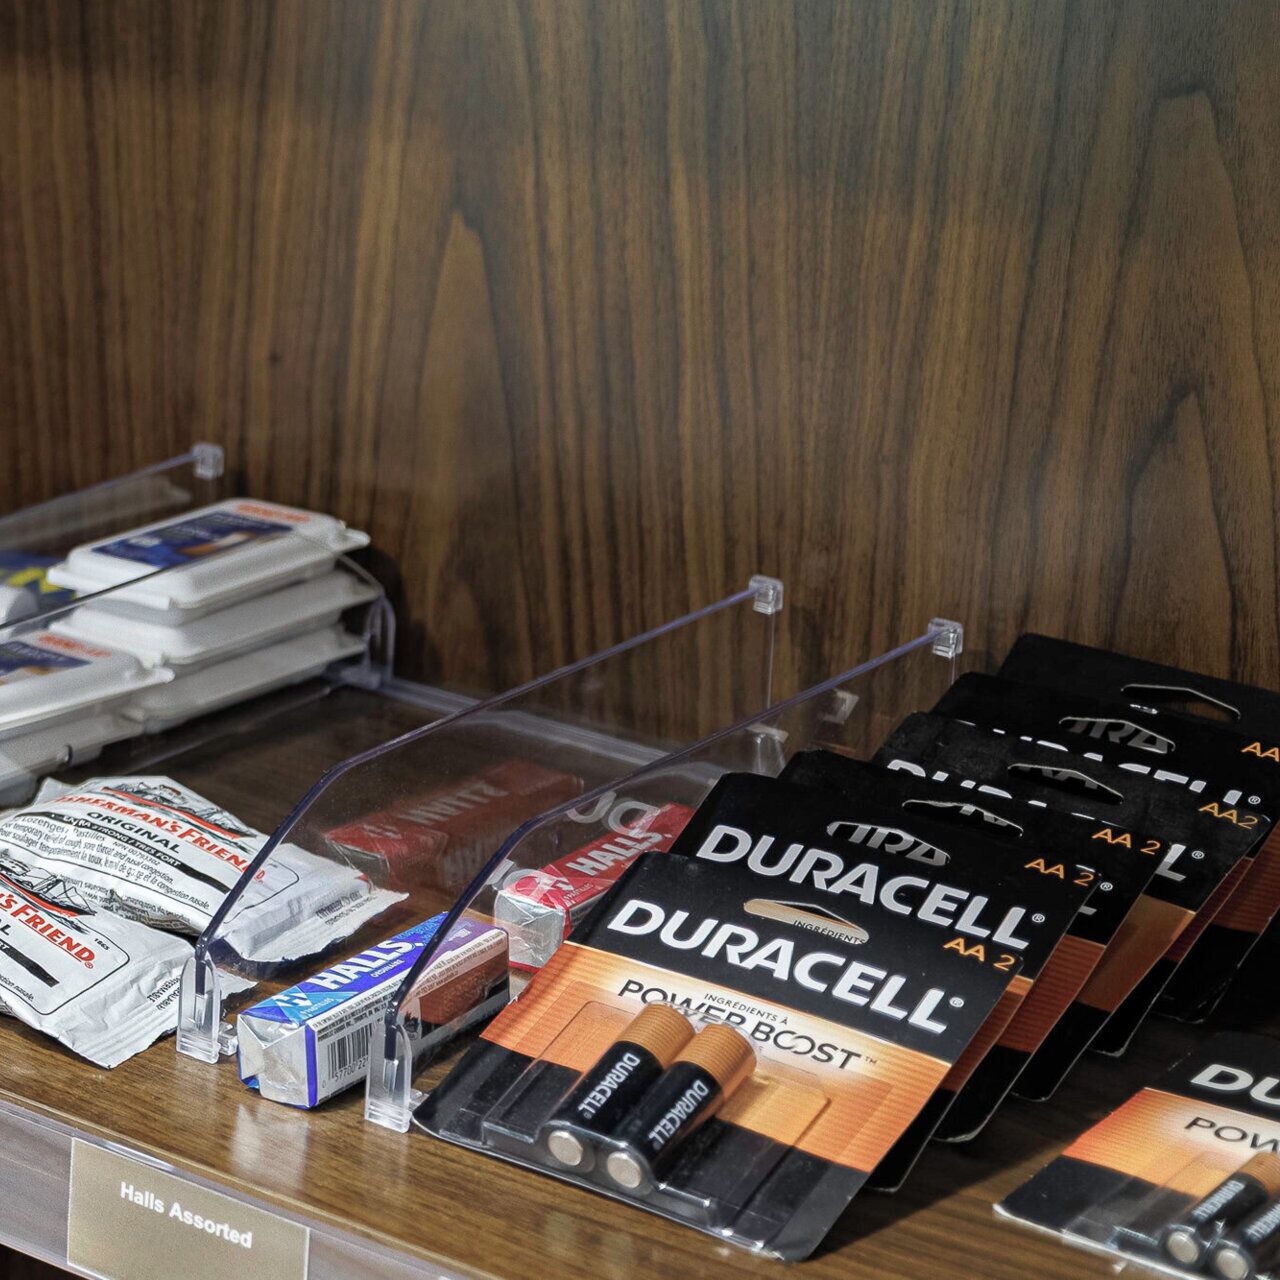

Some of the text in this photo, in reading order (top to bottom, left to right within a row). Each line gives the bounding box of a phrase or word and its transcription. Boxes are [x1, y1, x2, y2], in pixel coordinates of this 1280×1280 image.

[87, 811, 181, 855] ORIGINAL
[566, 825, 664, 877] HALLS
[1092, 827, 1161, 856] AA 2
[696, 823, 1032, 952] DURACELL
[1023, 857, 1095, 888] AA 2
[10, 903, 97, 964] FRIEND
[943, 936, 1017, 973] AA 2
[313, 939, 415, 990] HALLS
[606, 897, 951, 1035] DURACELL
[703, 992, 778, 1023] INGRÉDIENTS
[750, 1021, 863, 1071] BOOST
[577, 1052, 641, 1119] DURACELL
[647, 1079, 711, 1148] DURACELL
[120, 1181, 254, 1250] Halls Assorted
